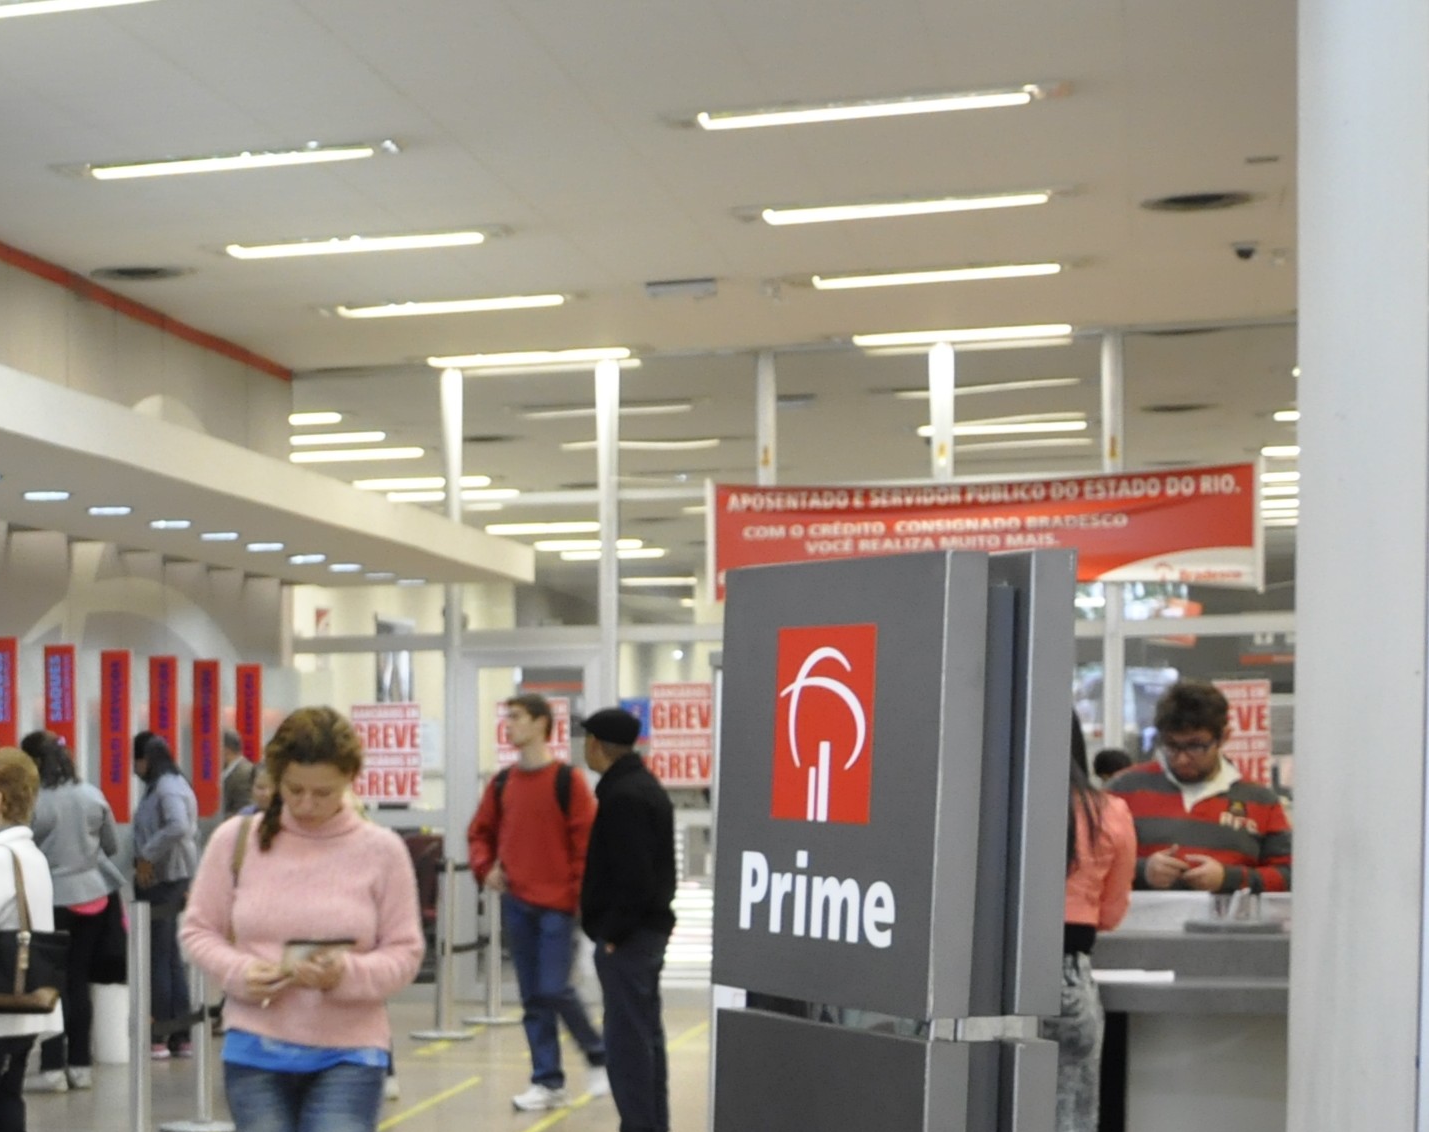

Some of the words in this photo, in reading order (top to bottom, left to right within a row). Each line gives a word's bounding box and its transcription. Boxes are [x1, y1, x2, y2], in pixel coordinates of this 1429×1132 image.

[726, 491, 851, 513] APOSENTADO
[852, 492, 865, 509] E
[870, 486, 963, 509] SERVIDOR
[1050, 481, 1080, 499] DO
[1083, 476, 1161, 499] ESTADO
[1165, 475, 1196, 497] DO
[1199, 473, 1242, 494] RIO.
[742, 523, 786, 541] COM
[789, 523, 805, 538] O
[894, 515, 1022, 536] CONSIGNADO
[1025, 512, 1129, 530] BRADESCO
[857, 536, 935, 552] REALIZA
[939, 533, 1001, 550] MUITO
[1005, 533, 1061, 547] MAIS.
[651, 703, 712, 730] GREV
[651, 753, 712, 779] GREV
[738, 849, 897, 949] Prime
